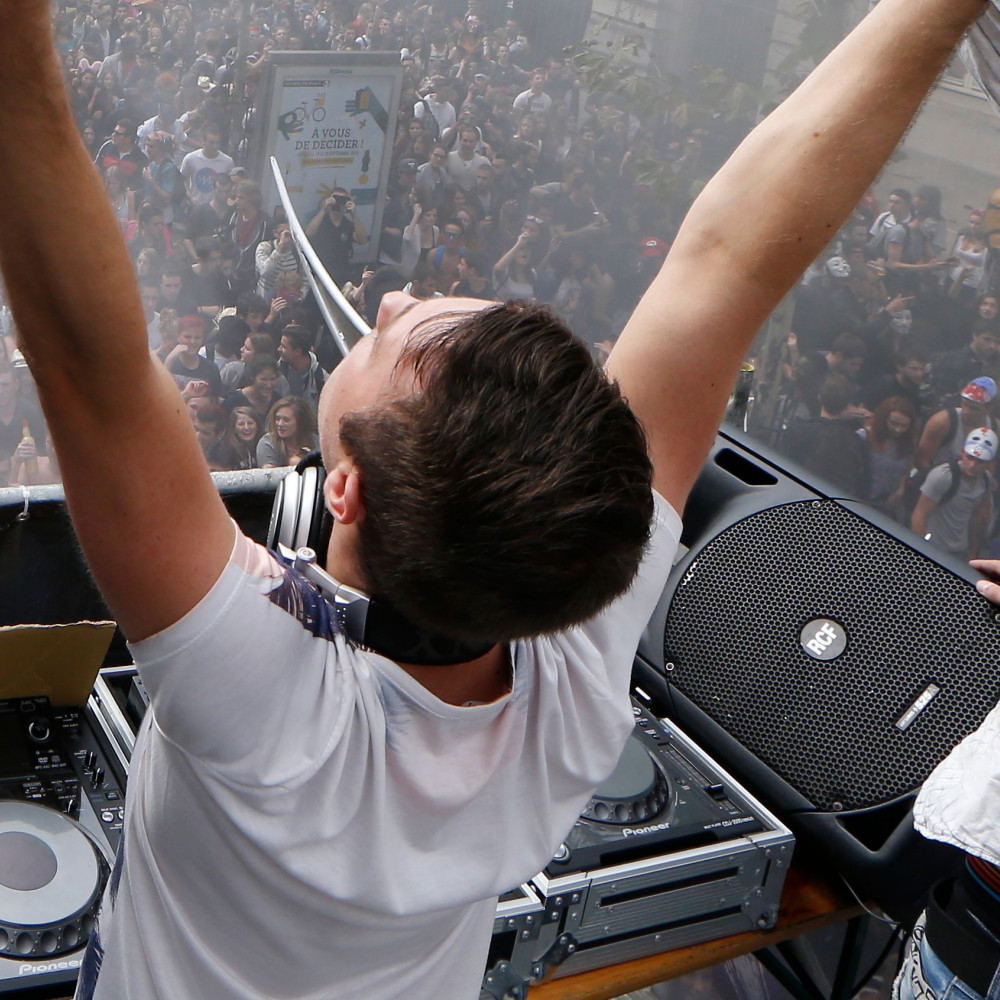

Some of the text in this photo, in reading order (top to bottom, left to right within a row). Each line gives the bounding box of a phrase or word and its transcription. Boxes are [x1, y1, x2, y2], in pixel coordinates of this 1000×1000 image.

[321, 128, 351, 138] VOUS
[295, 140, 310, 150] DE
[806, 622, 838, 656] RCF
[622, 822, 670, 838] Pioneer
